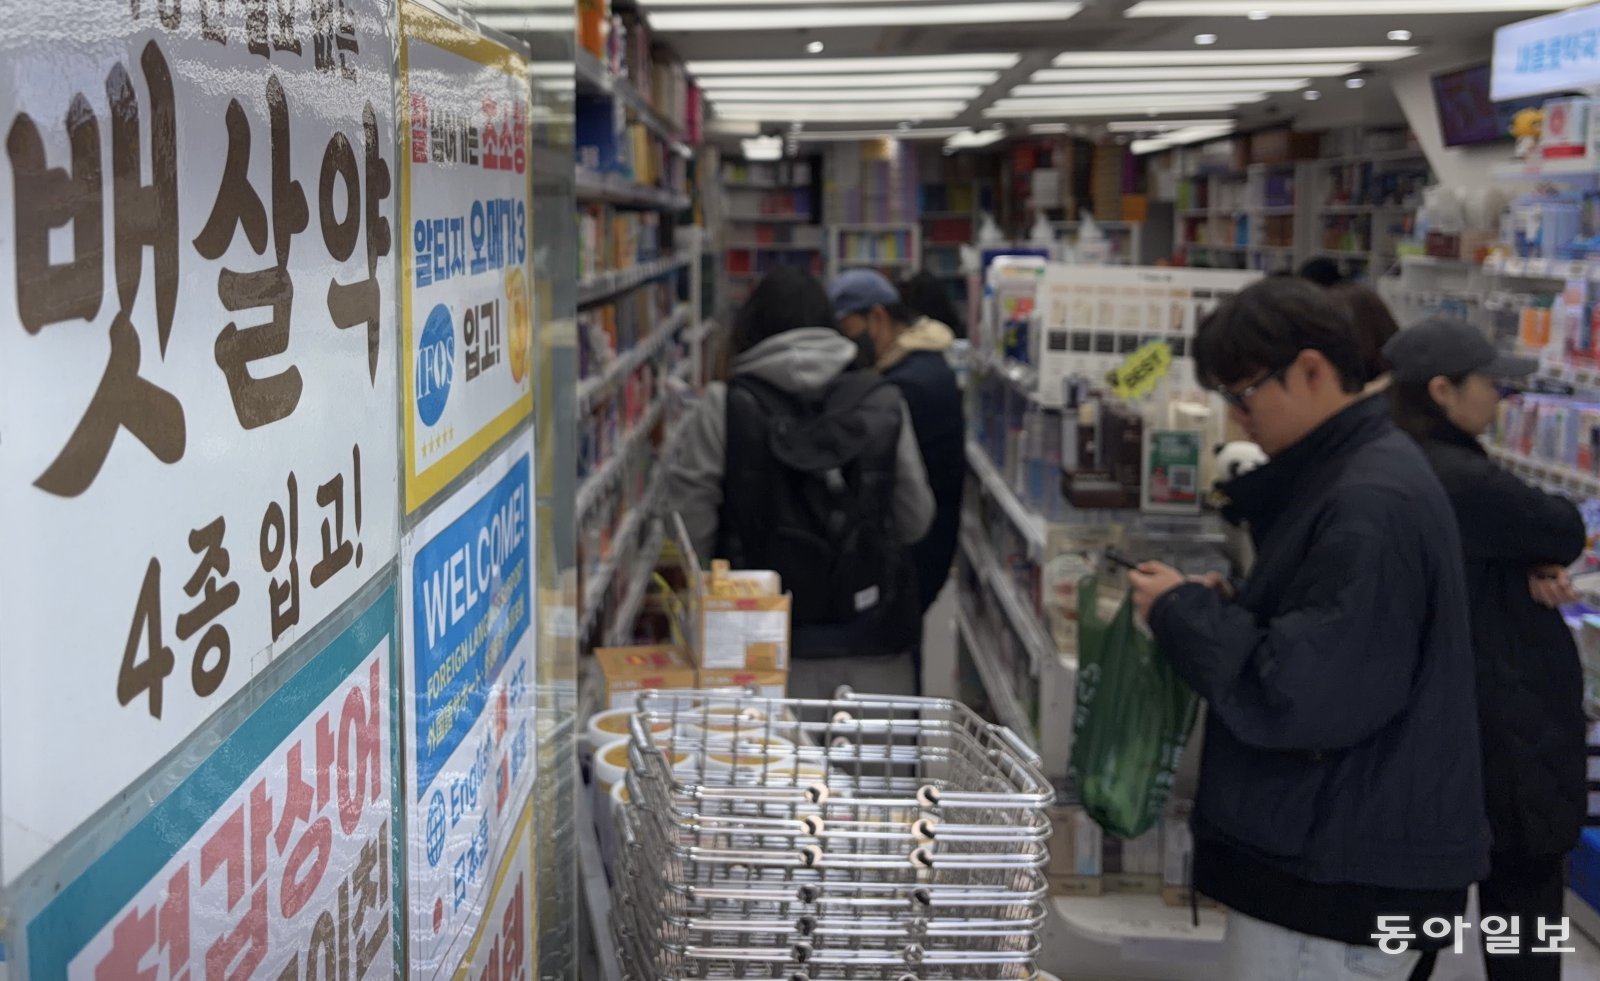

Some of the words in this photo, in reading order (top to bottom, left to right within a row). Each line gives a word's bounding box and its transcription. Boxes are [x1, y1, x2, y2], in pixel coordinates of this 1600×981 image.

[481, 94, 526, 175] 초소형
[7, 39, 391, 498] 뱃살약
[414, 215, 465, 288] 알티지
[470, 198, 526, 276] 오메가3
[416, 336, 455, 401] IFOS
[463, 298, 500, 382] 입고!
[117, 515, 240, 720] 4종
[259, 443, 363, 643] 입고!
[423, 483, 524, 650] WELCOME!
[427, 638, 468, 707] FOREIGN
[451, 731, 492, 829] English
